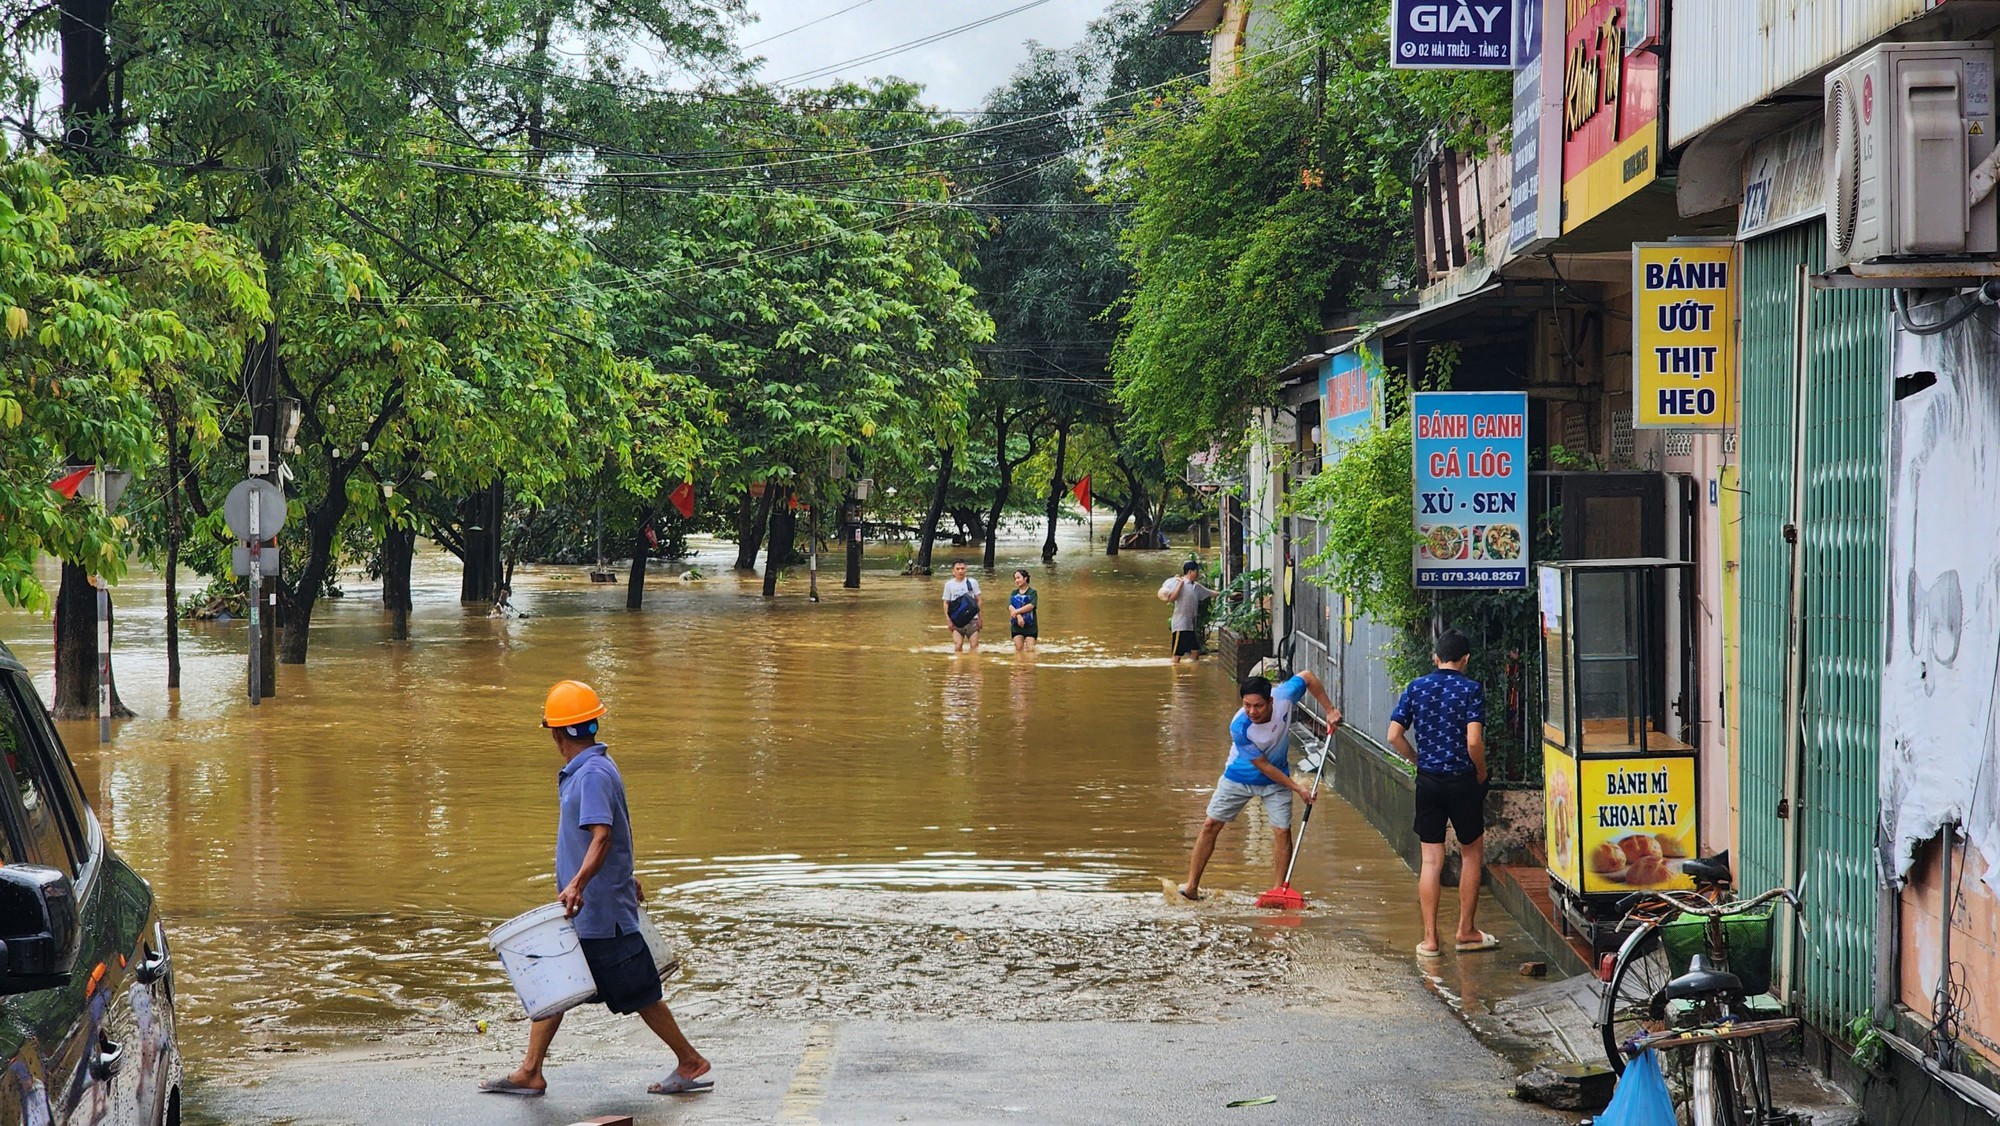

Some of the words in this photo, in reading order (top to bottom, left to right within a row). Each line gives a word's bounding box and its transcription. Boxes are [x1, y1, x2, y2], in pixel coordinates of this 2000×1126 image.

[1410, 0, 1503, 33] GIÀY
[1418, 44, 1429, 57] 02
[1479, 41, 1499, 58] TẦNG
[1501, 44, 1507, 58] 2
[1863, 134, 1873, 161] LG
[1645, 257, 1727, 290] BÁNH
[1658, 299, 1714, 332] ƯỚT
[1655, 346, 1717, 379] THỊT
[1658, 388, 1716, 416] HEO
[1418, 410, 1468, 439] BÁNH
[1473, 414, 1523, 438] CANH
[1429, 447, 1462, 478] CÁ
[1468, 447, 1512, 478] LÓC
[1421, 487, 1454, 514] XÙ
[1472, 492, 1517, 513] SEN
[1421, 572, 1439, 582] ĐT:
[1442, 571, 1521, 582] 079.340.8267
[1606, 767, 1648, 795] BÁNH
[1651, 765, 1668, 794] MÌ
[1598, 805, 1646, 828] KHOAI
[1648, 797, 1678, 826] TÂY
